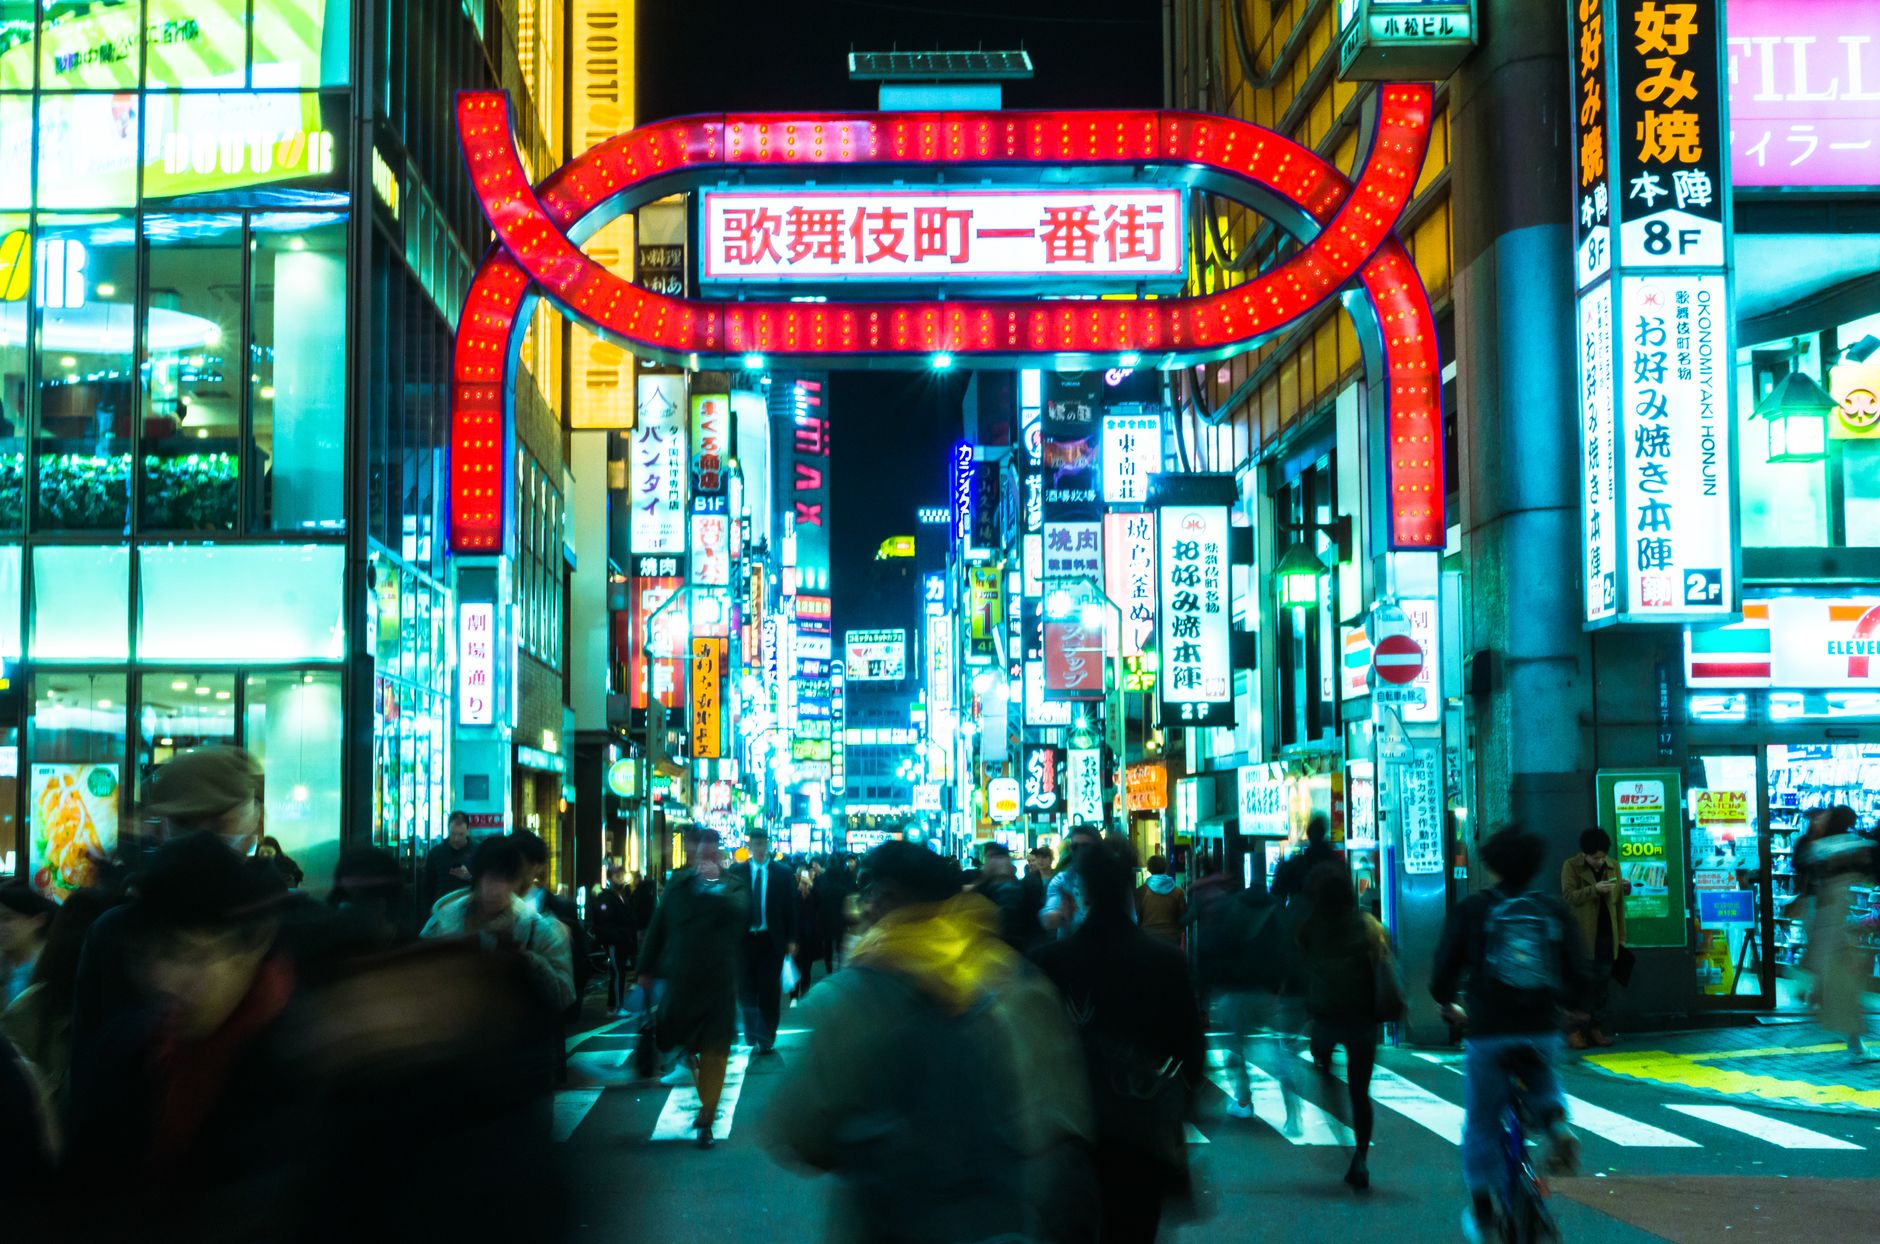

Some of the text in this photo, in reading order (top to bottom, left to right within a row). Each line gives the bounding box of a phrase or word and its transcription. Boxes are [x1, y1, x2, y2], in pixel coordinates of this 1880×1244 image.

[1384, 17, 1453, 36] 小松ビル
[1633, 2, 1702, 164] 好み焼
[1730, 125, 1871, 167] ィラー
[1630, 171, 1711, 208] 本陣
[723, 205, 1163, 264] 歌舞伎町一番街
[1644, 221, 1701, 255] 8F
[1676, 290, 1692, 381] 歌舞伎町名物
[1697, 290, 1717, 496] OKONOMIYAKI HONJIN
[1633, 316, 1673, 572] お好み焼き本陣
[639, 426, 663, 515] バンタイ
[694, 496, 725, 511] B1F
[1048, 528, 1098, 551] 焼肉
[640, 557, 677, 577] 焼肉
[1686, 573, 1721, 601] 2F
[1181, 703, 1209, 720] 2F
[1377, 691, 1423, 702] 自転車を除く
[1415, 759, 1430, 851] 防犯カメラ作動中
[1426, 752, 1439, 858] みなさまの安全を守ります
[1698, 792, 1747, 803] ATM
[1622, 842, 1663, 857] 300円
